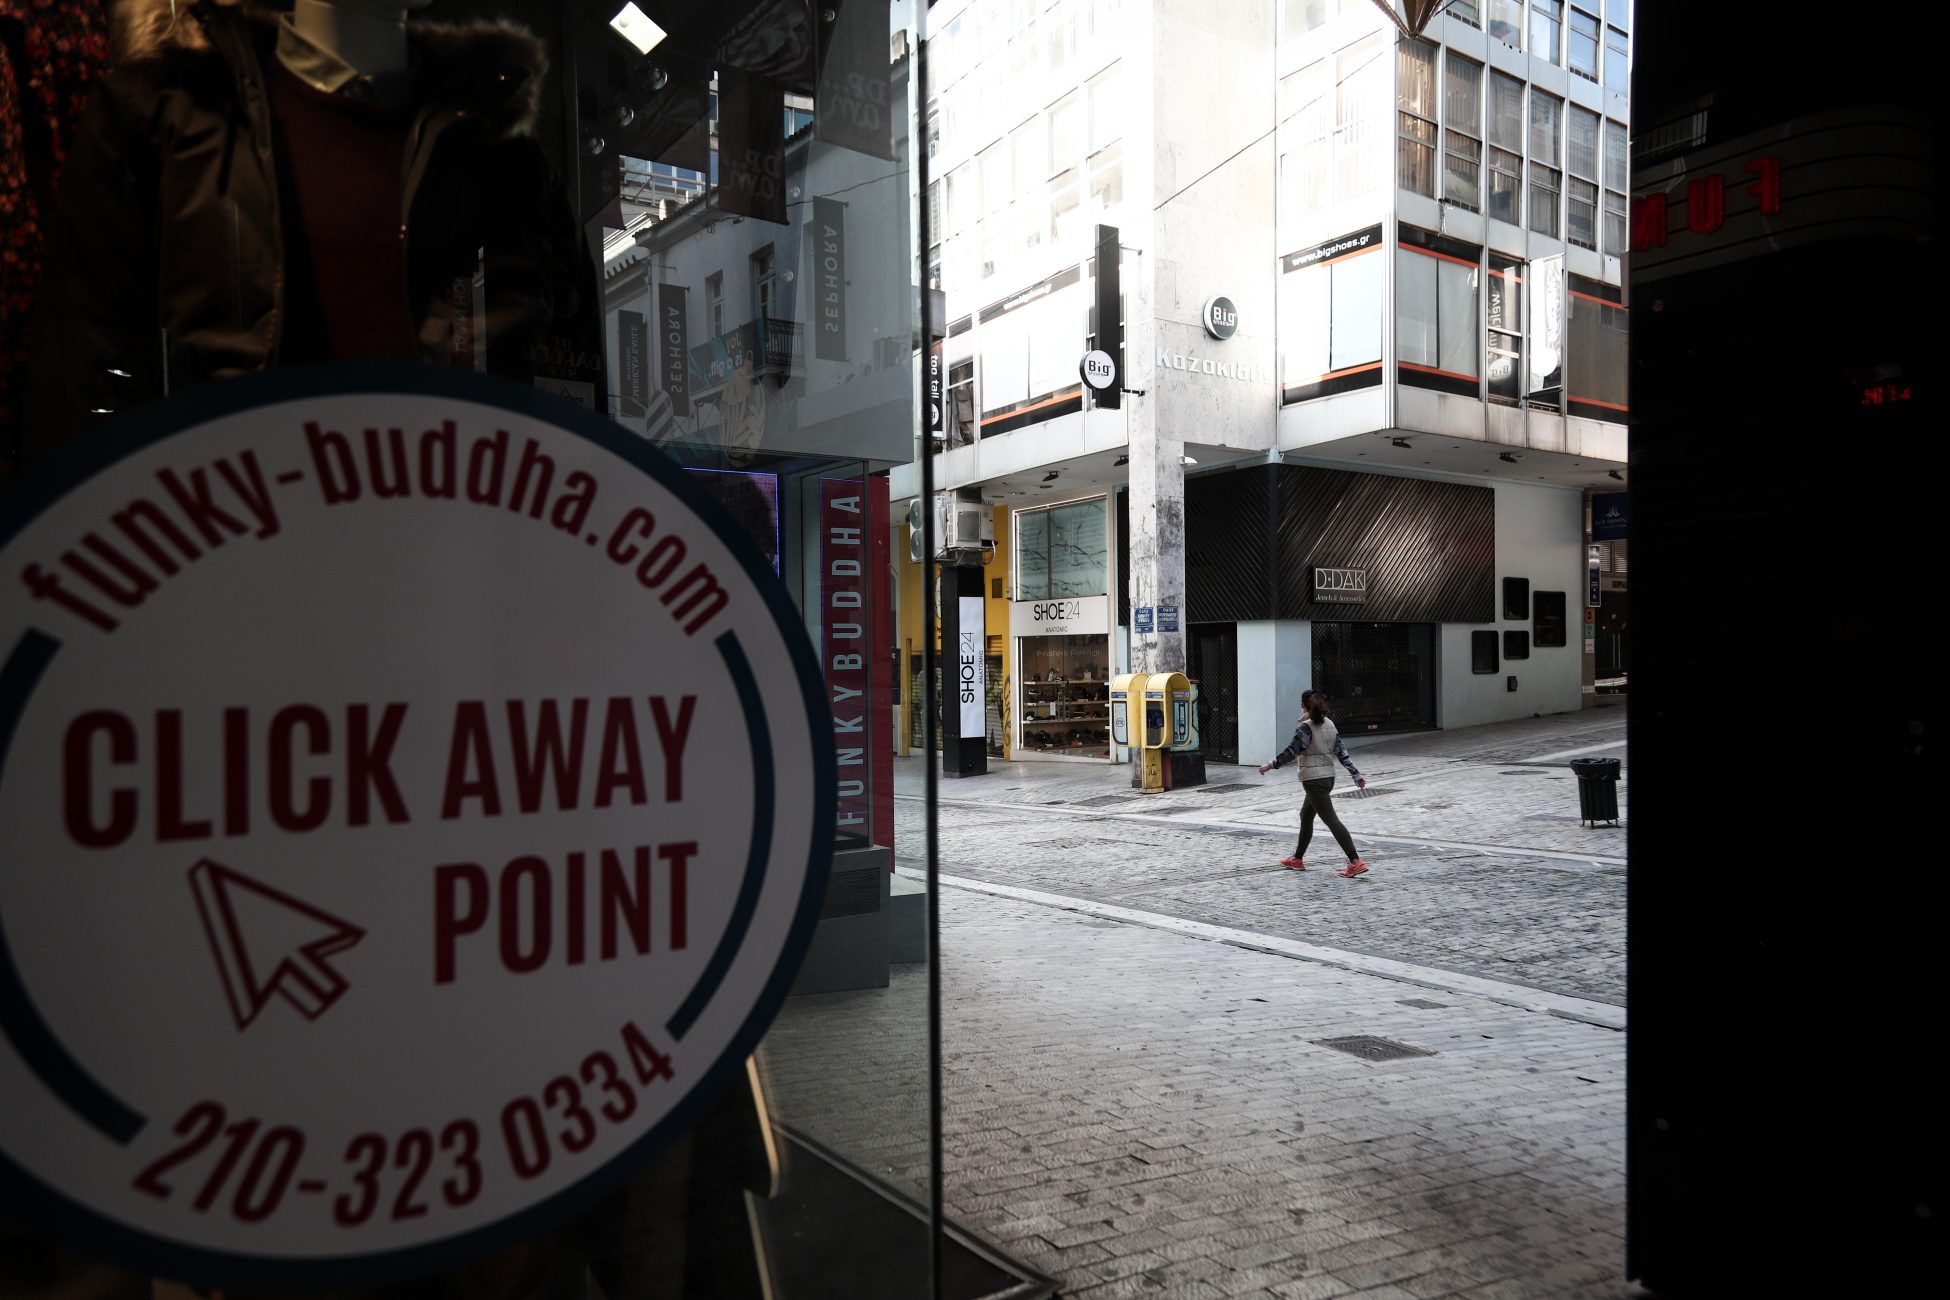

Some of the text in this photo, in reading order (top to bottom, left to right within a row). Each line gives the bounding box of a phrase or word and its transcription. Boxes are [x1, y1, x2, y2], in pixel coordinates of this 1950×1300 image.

[1291, 234, 1371, 267] www.bigshoes.gr
[1213, 306, 1235, 327] Big
[1088, 360, 1110, 377] Big
[23, 419, 730, 638] funky-buddha.com
[1045, 625, 1068, 633] ANATOMIC
[64, 694, 698, 848] CLICK AWAY
[434, 841, 699, 985] POINT
[132, 1021, 677, 1228] 210-323 0334
